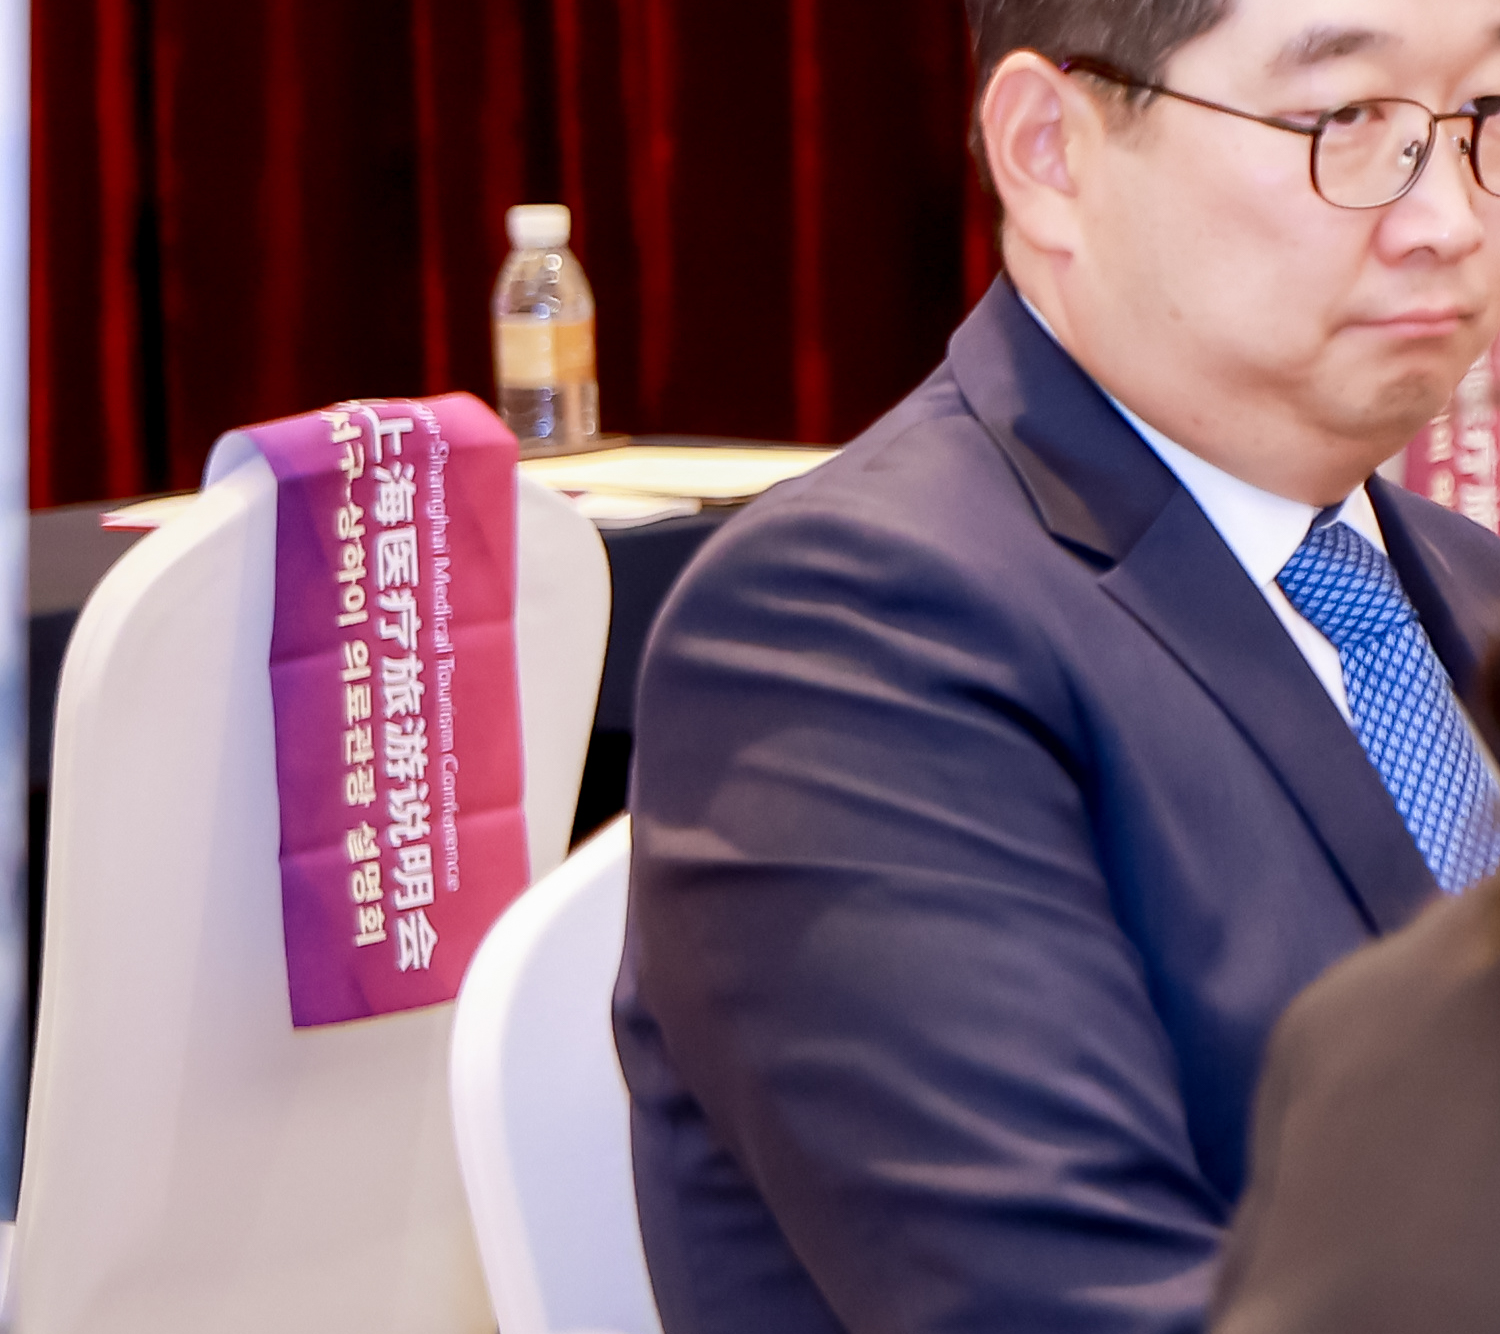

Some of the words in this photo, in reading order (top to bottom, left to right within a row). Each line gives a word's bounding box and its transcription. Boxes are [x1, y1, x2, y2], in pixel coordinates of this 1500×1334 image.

[433, 556, 455, 654] Medical
[342, 639, 376, 807] 의료관광
[364, 409, 438, 972] 上海医疗旅游说明会
[436, 656, 457, 752] Tourism
[347, 820, 387, 948] 설명회
[439, 753, 460, 892] Conference
